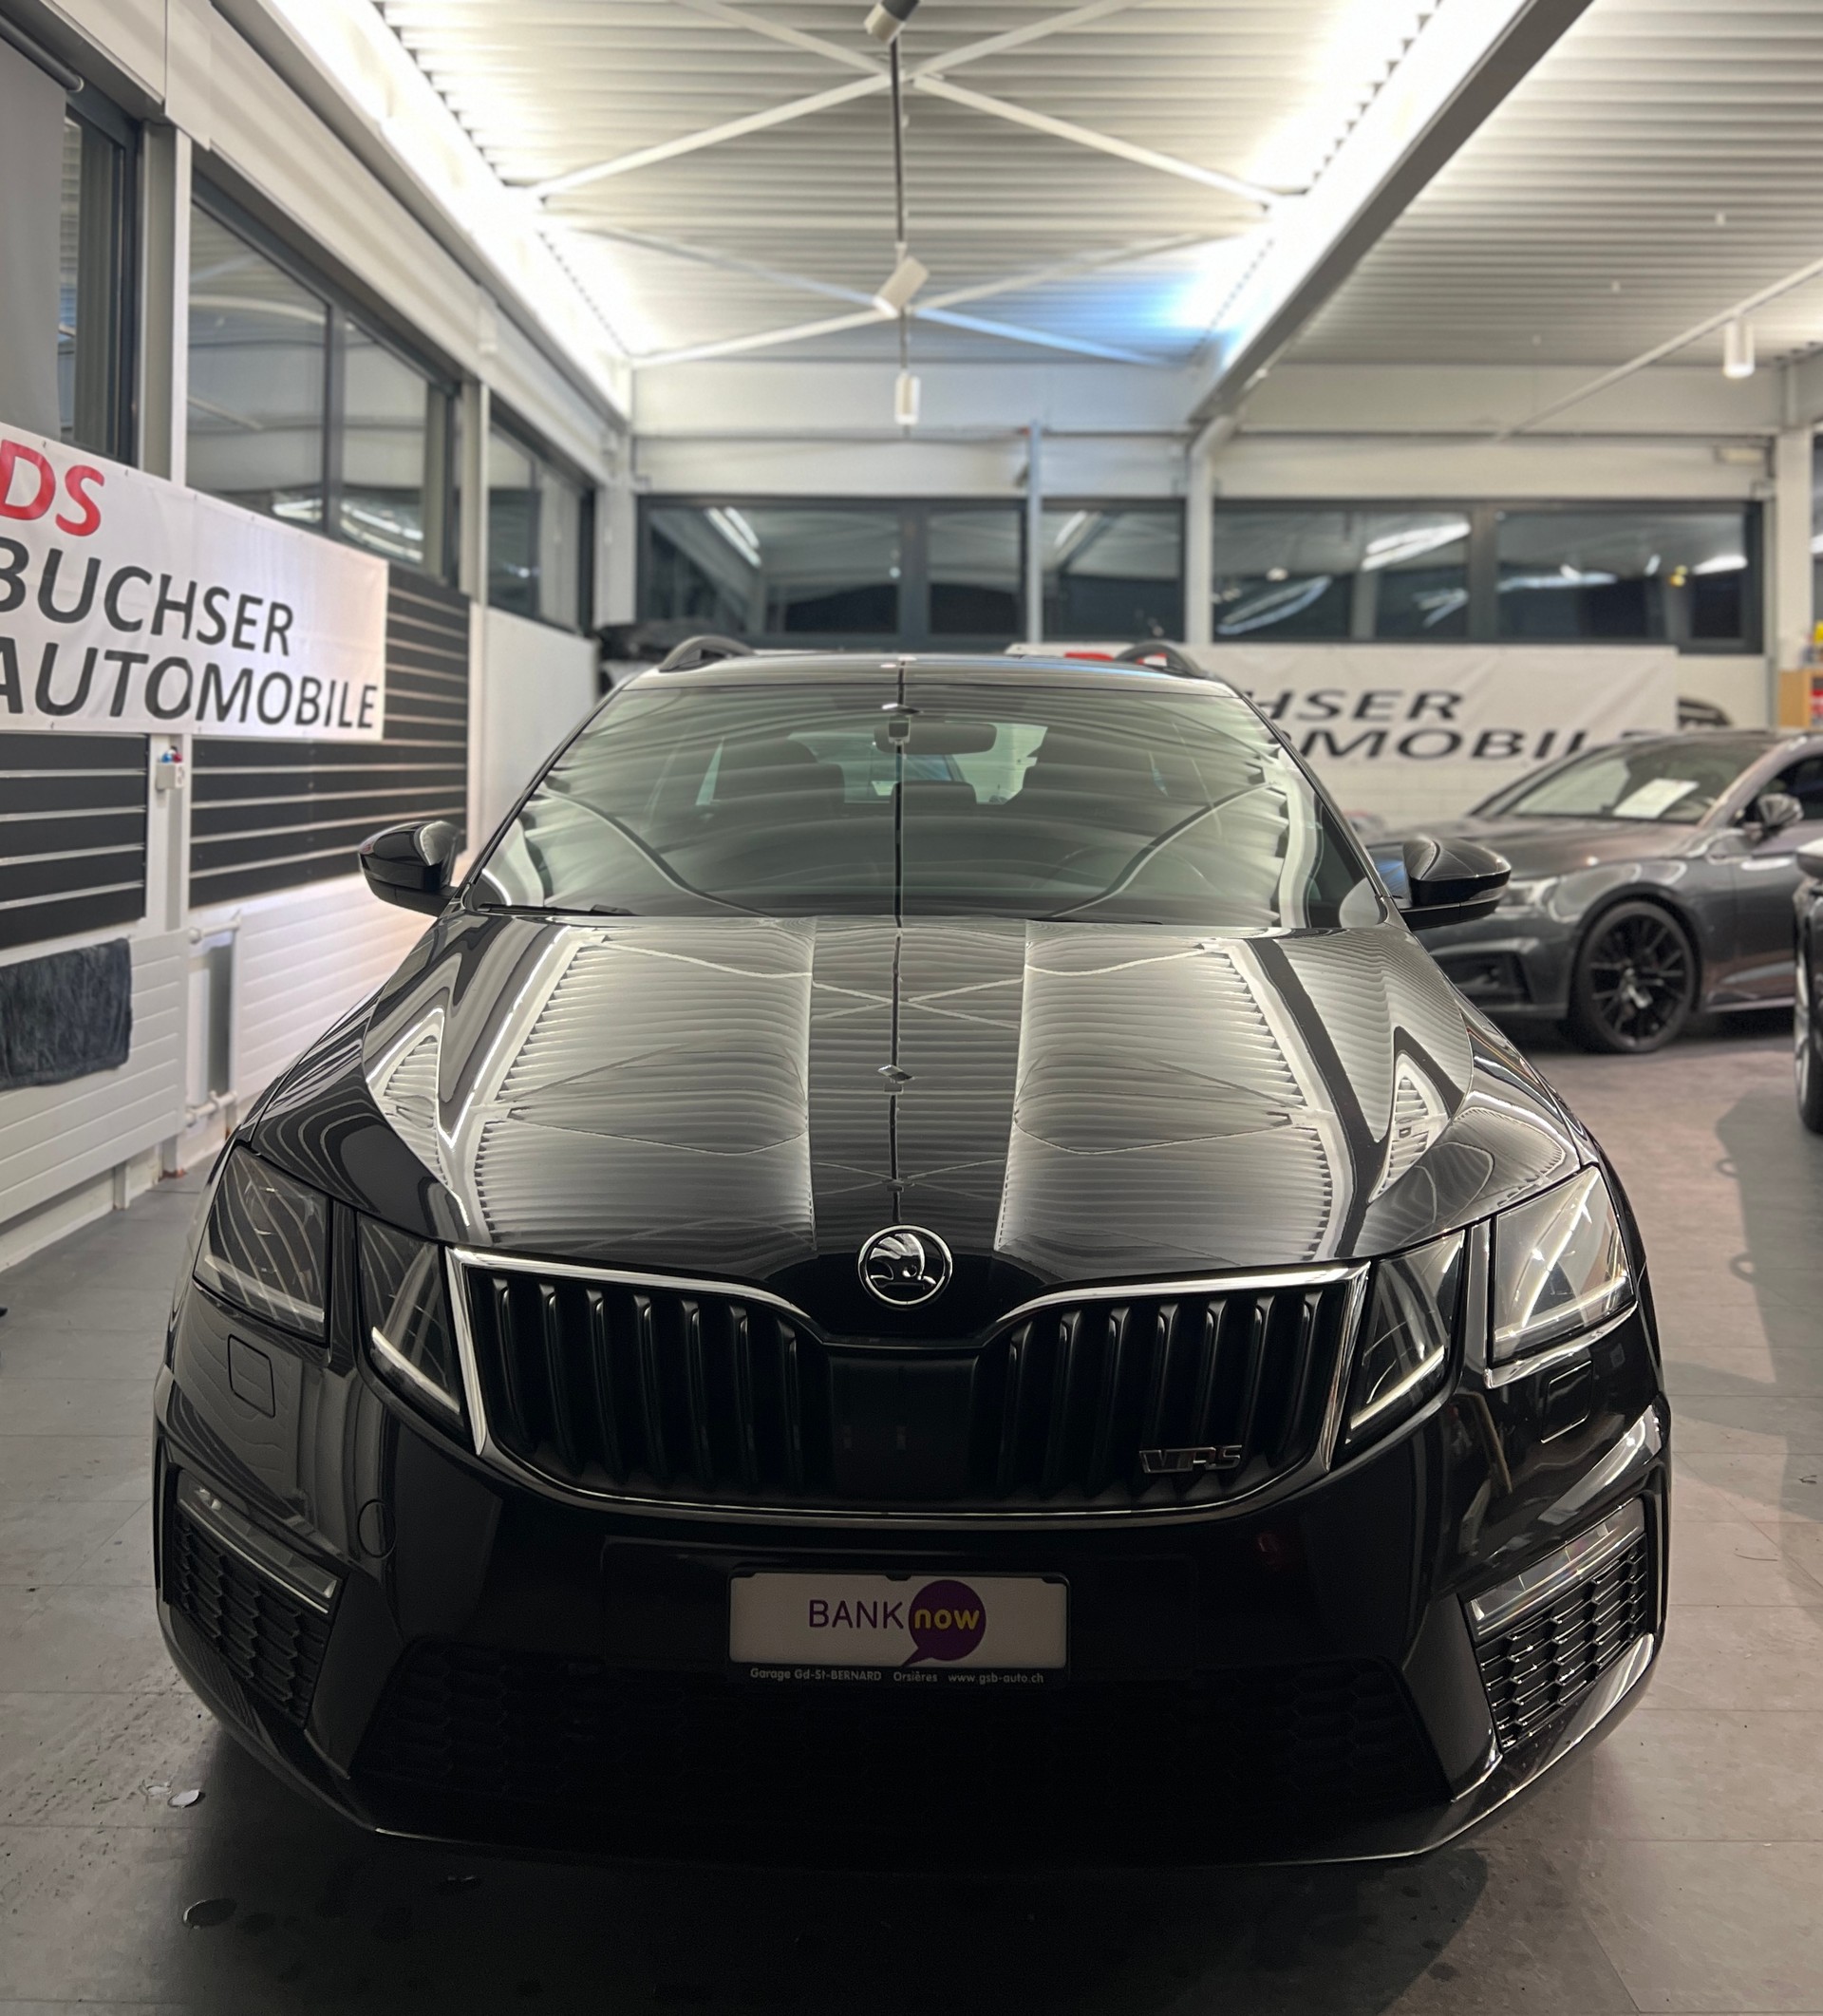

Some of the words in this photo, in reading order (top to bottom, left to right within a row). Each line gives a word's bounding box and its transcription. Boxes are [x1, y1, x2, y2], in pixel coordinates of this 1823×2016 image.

[809, 1599, 904, 1630] BANK
[913, 1608, 980, 1630] now
[750, 1667, 791, 1682] Garage
[794, 1667, 882, 1682] Gd-St-BERNARD
[893, 1670, 938, 1683] Orsières
[948, 1672, 1044, 1686] www.gsb-auto.ch
